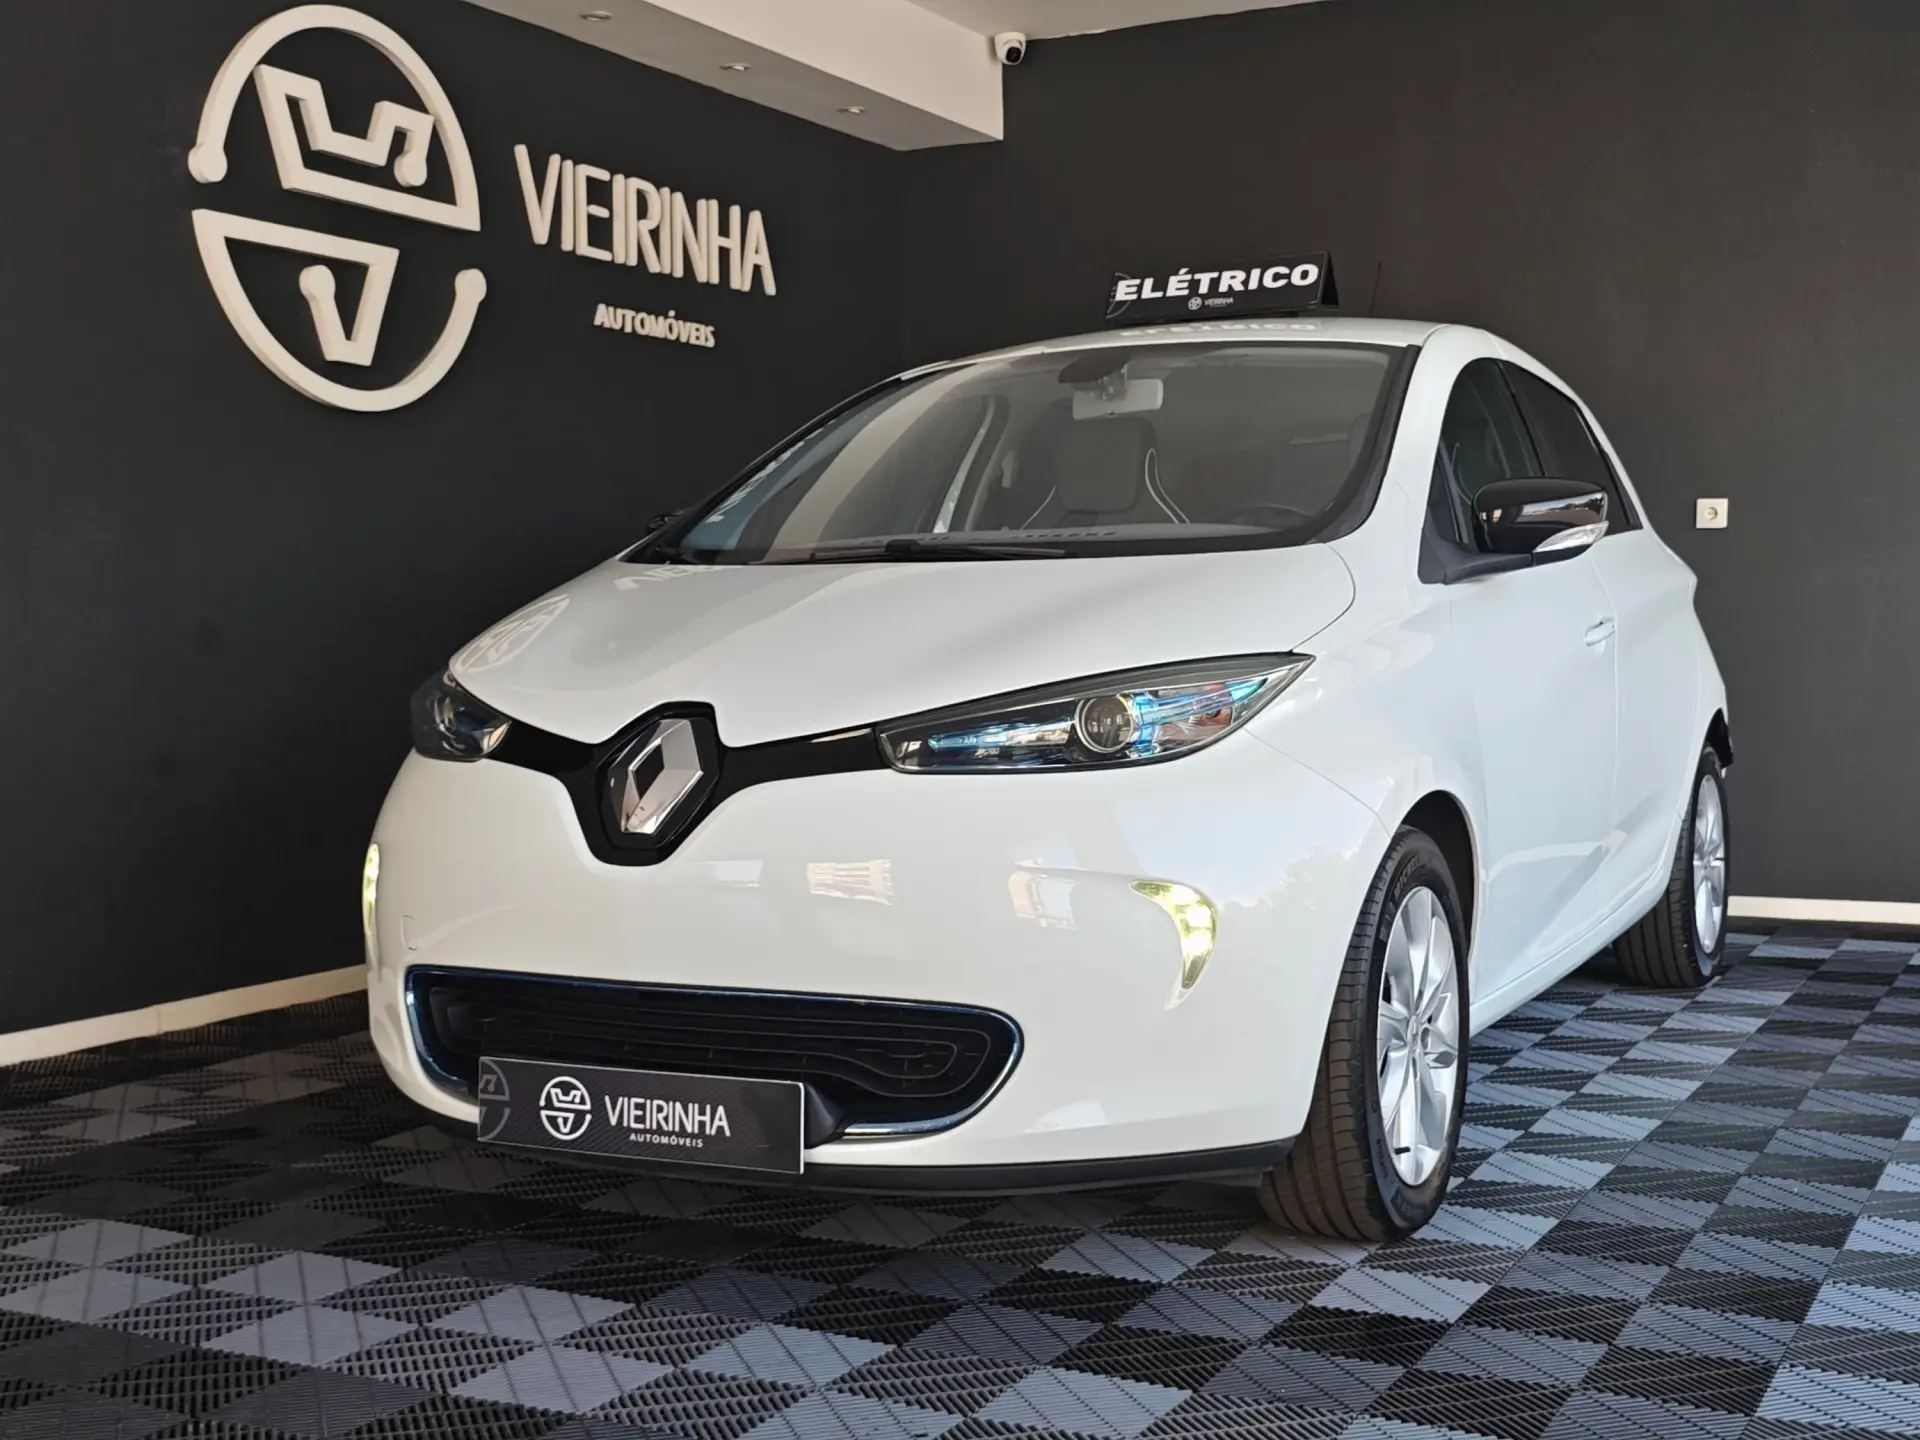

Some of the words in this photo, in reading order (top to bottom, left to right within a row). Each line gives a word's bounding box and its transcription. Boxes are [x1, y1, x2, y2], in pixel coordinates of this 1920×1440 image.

[514, 143, 777, 296] VIERINHA
[1114, 263, 1319, 302] ELÉTRICO
[593, 303, 716, 348] AUTOMÓVEIS
[604, 1095, 731, 1137] VIERINHA
[629, 1131, 704, 1148] AUTOMÓVEIS
